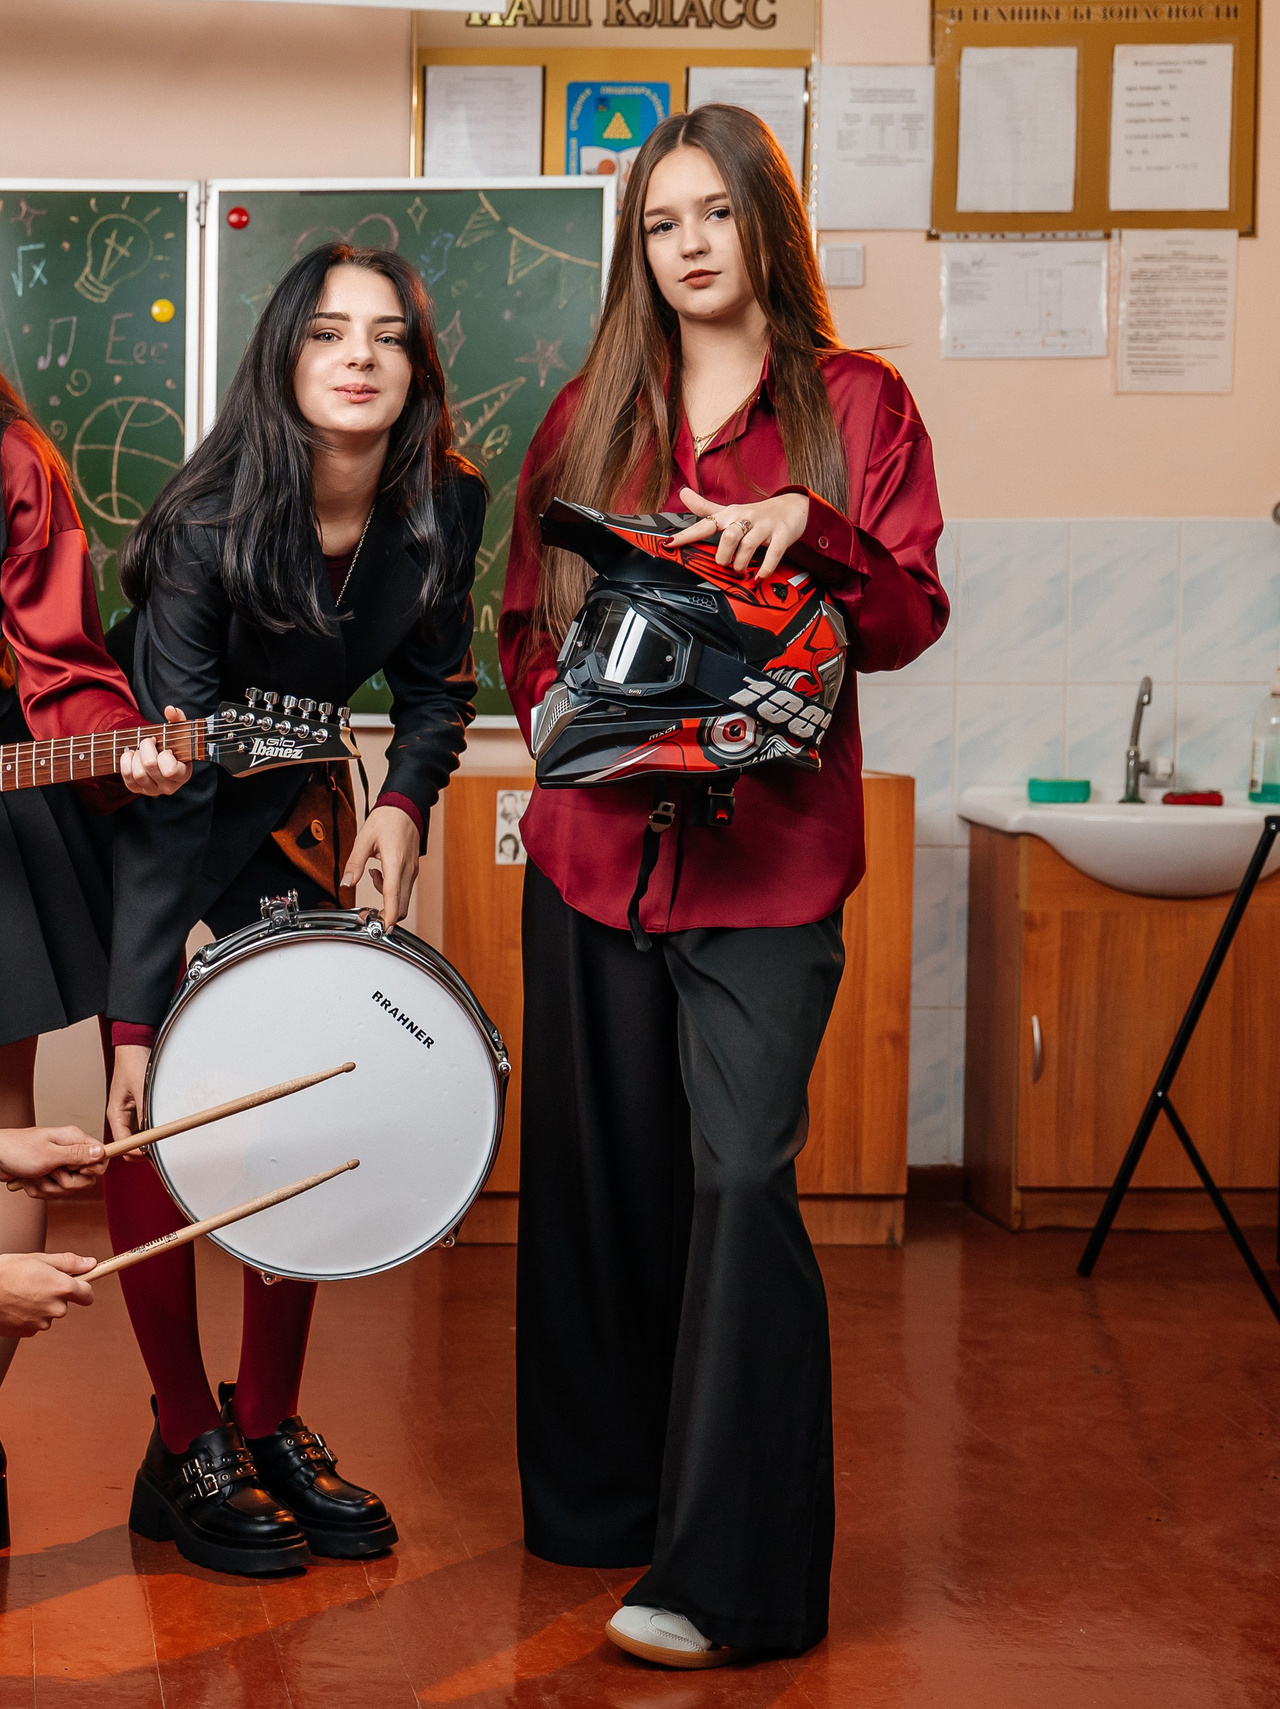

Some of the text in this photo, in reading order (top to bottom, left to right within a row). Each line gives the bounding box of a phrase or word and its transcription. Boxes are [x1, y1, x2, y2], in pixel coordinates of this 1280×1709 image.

[603, 0, 777, 29] КЛАСС
[970, 7, 1062, 22] ТЕХНИКЕ
[1072, 5, 1239, 22] БЕЗОПАСНОСТИ
[249, 737, 304, 760] Ibanez
[371, 990, 435, 1050] BRAHNER
